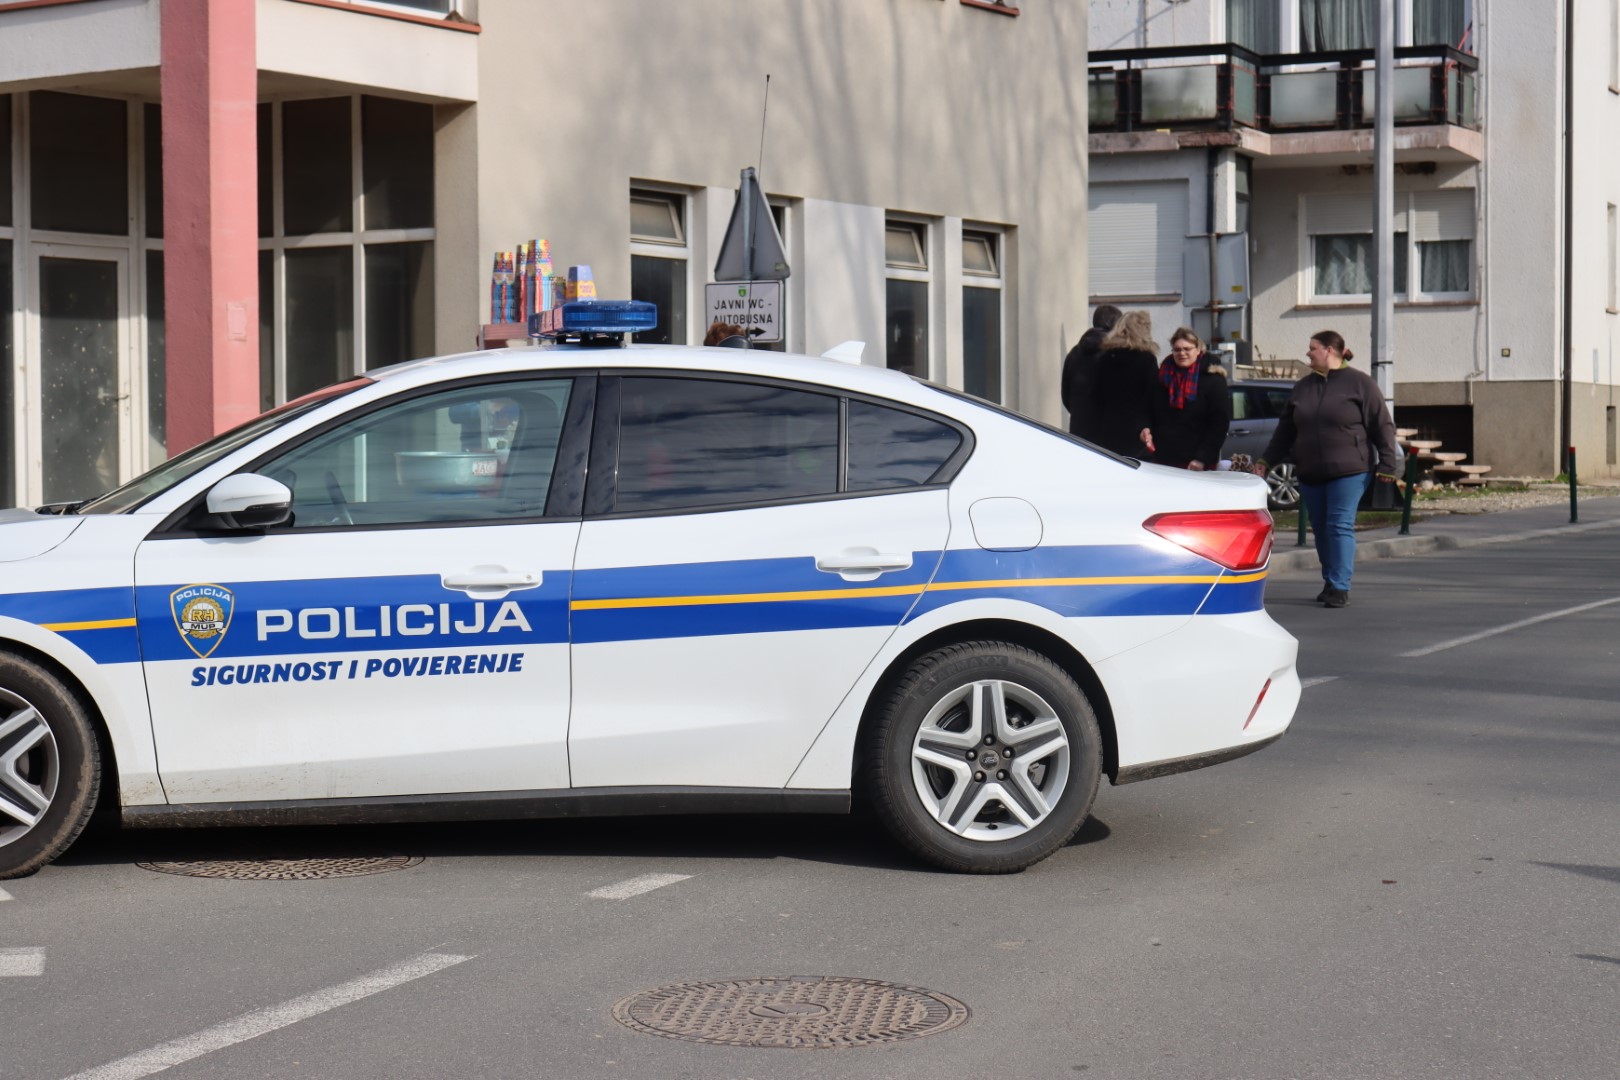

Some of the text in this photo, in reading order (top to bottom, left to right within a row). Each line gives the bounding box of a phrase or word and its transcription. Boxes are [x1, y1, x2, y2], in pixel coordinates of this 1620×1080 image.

[714, 300, 744, 310] JAVNI
[748, 299, 764, 309] WC
[713, 314, 773, 324] AUTOBUSNA
[176, 588, 231, 602] POLICIJA
[191, 608, 215, 622] RH
[256, 600, 533, 641] POLICIJA
[191, 653, 525, 687] SIGURNOST I POVJERENJE
